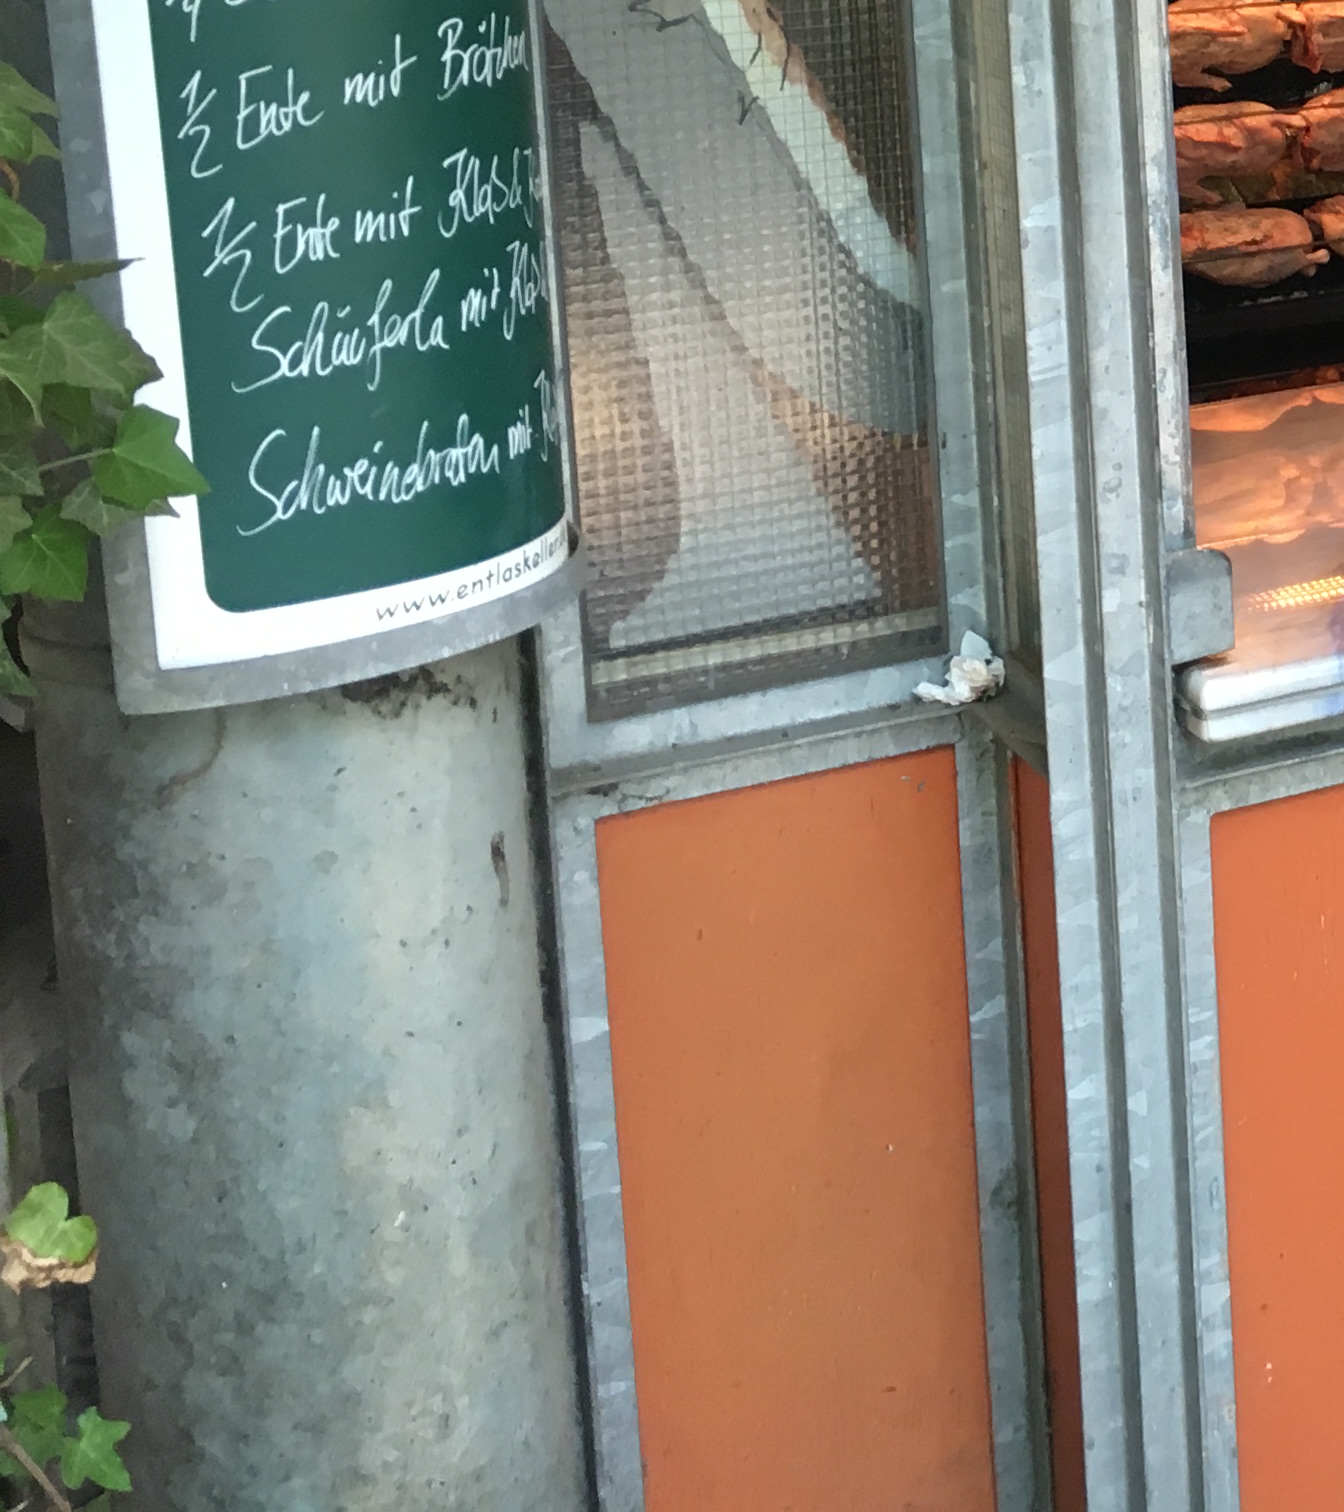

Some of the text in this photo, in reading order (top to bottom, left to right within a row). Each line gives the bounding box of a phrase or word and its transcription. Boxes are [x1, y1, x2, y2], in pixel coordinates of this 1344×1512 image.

[236, 65, 324, 150] Ente
[343, 33, 417, 107] mit
[436, 11, 530, 101] Brötchen
[272, 193, 340, 275] Ente
[354, 174, 422, 244] mit
[460, 267, 501, 332] mit
[236, 412, 500, 536] Schweinebraten
[506, 403, 533, 460] mit
